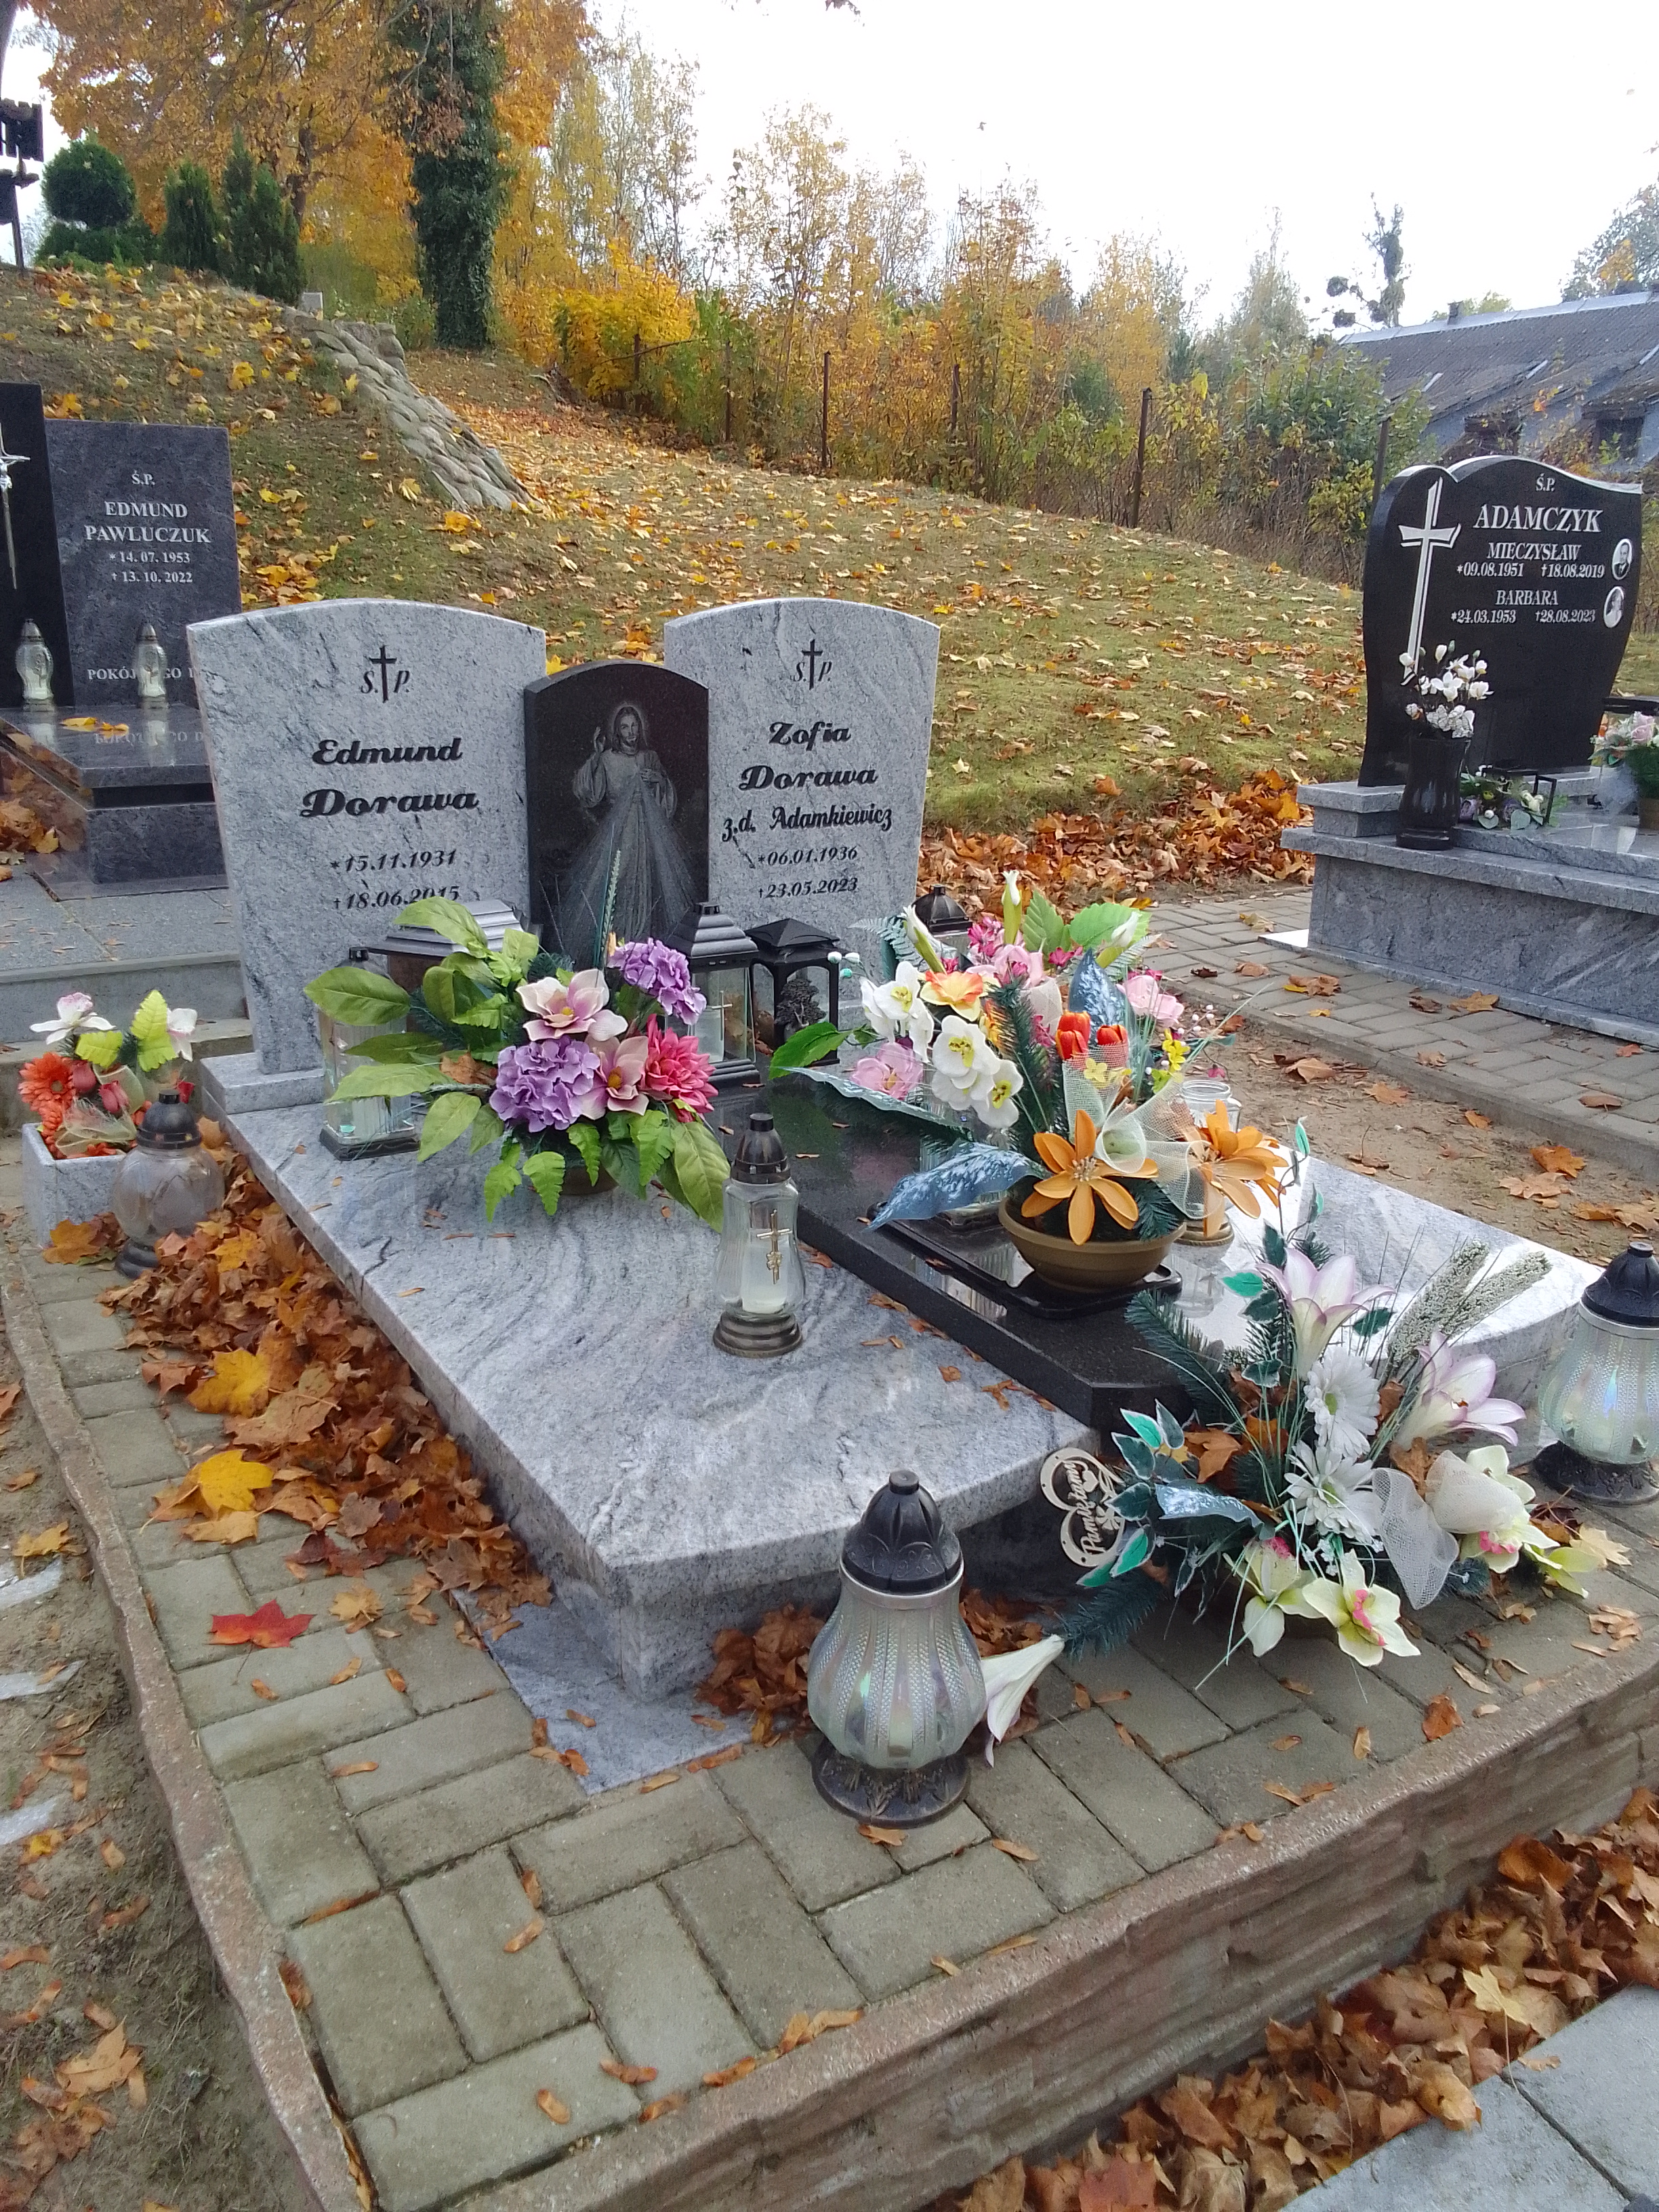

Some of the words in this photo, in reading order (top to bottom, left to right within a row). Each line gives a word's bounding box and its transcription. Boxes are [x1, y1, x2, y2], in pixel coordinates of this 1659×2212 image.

[131, 470, 156, 485] Ś.P.
[1535, 473, 1556, 492] Ś.P.
[104, 501, 188, 518] EDMUND
[1473, 504, 1603, 533] ADAMCZYK
[84, 525, 211, 543] PAWLUCZUK
[1486, 542, 1582, 561] MIECZYSŁAW
[1495, 590, 1559, 605] BARBARA
[769, 721, 851, 752] Zofia
[312, 737, 464, 765] Edmund
[738, 764, 878, 791] Dorawa
[300, 788, 480, 817] Dorawa
[769, 803, 893, 832] Adamkiewicz
